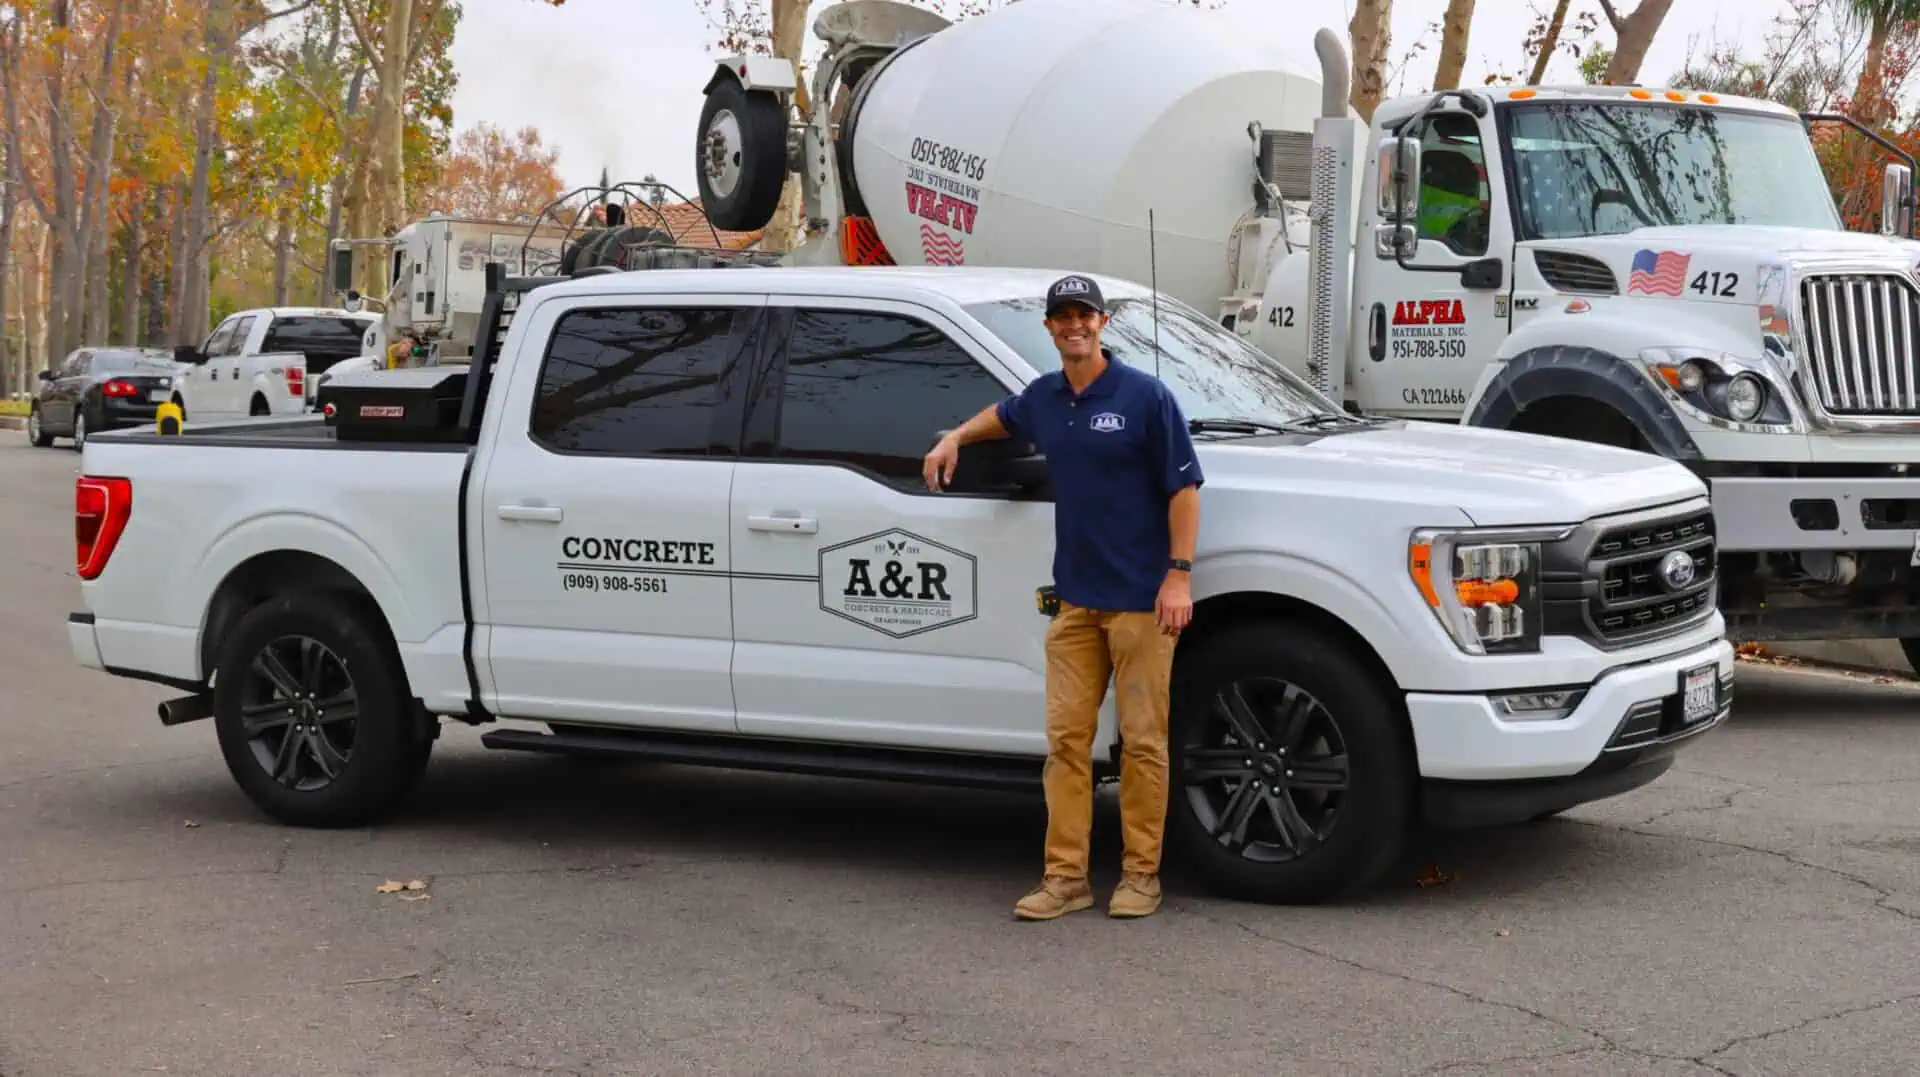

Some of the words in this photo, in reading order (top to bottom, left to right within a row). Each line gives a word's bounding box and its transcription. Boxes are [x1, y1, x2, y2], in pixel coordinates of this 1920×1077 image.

[911, 137, 986, 181] 951-788-5150
[905, 181, 978, 234] ALPHA
[1690, 270, 1738, 297] 412
[1268, 306, 1294, 328] 412
[1392, 299, 1466, 325] ALPHA
[1392, 339, 1466, 359] 951-788-5150
[1402, 388, 1420, 405] CA
[1420, 388, 1466, 405] 222666
[562, 537, 714, 564] CONCRETE
[562, 573, 600, 592] (909)
[603, 576, 669, 593] 908-5561
[843, 558, 952, 601] A&R
